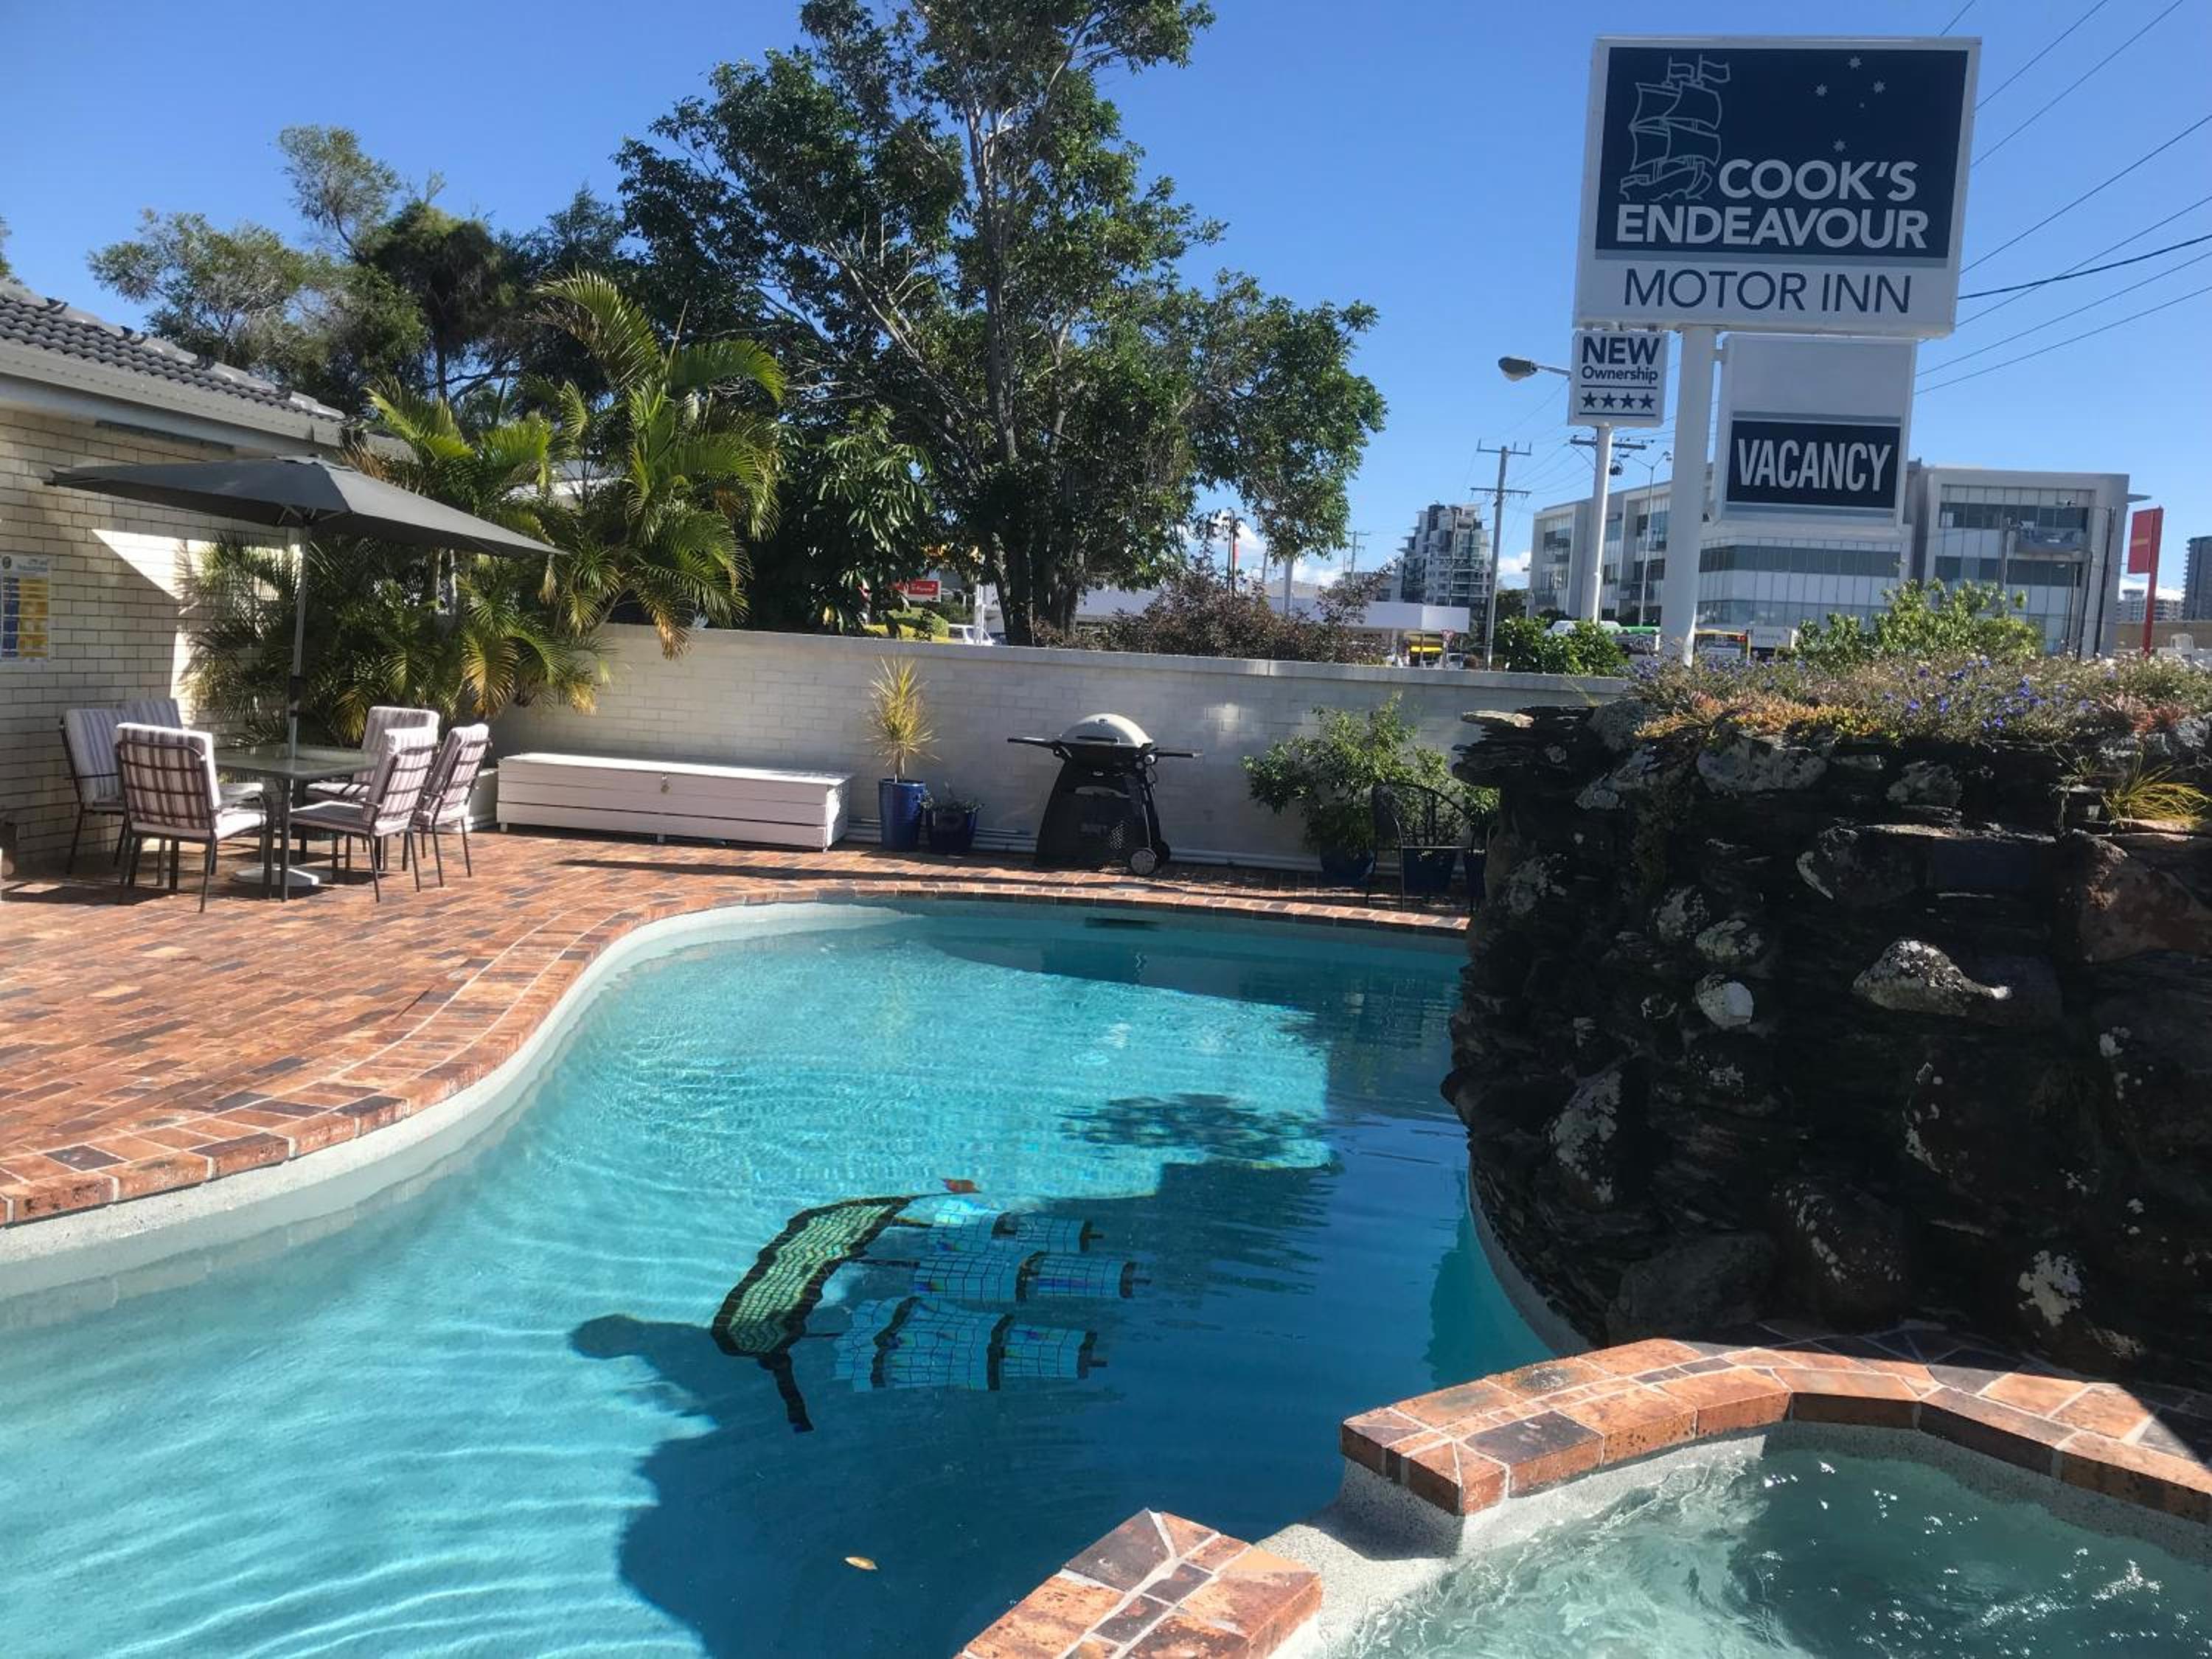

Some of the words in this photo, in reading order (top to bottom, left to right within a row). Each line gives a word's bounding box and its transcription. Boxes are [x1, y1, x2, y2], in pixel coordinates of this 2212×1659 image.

[1719, 159, 1919, 202] COOK'S
[1616, 204, 1928, 249] ENDEAVOUR
[1624, 268, 1806, 312] MOTOR
[1821, 274, 1912, 314] INN
[1582, 336, 1660, 365] NEW
[1582, 365, 1658, 384] Ownership
[1738, 438, 1892, 492] VACANCY
